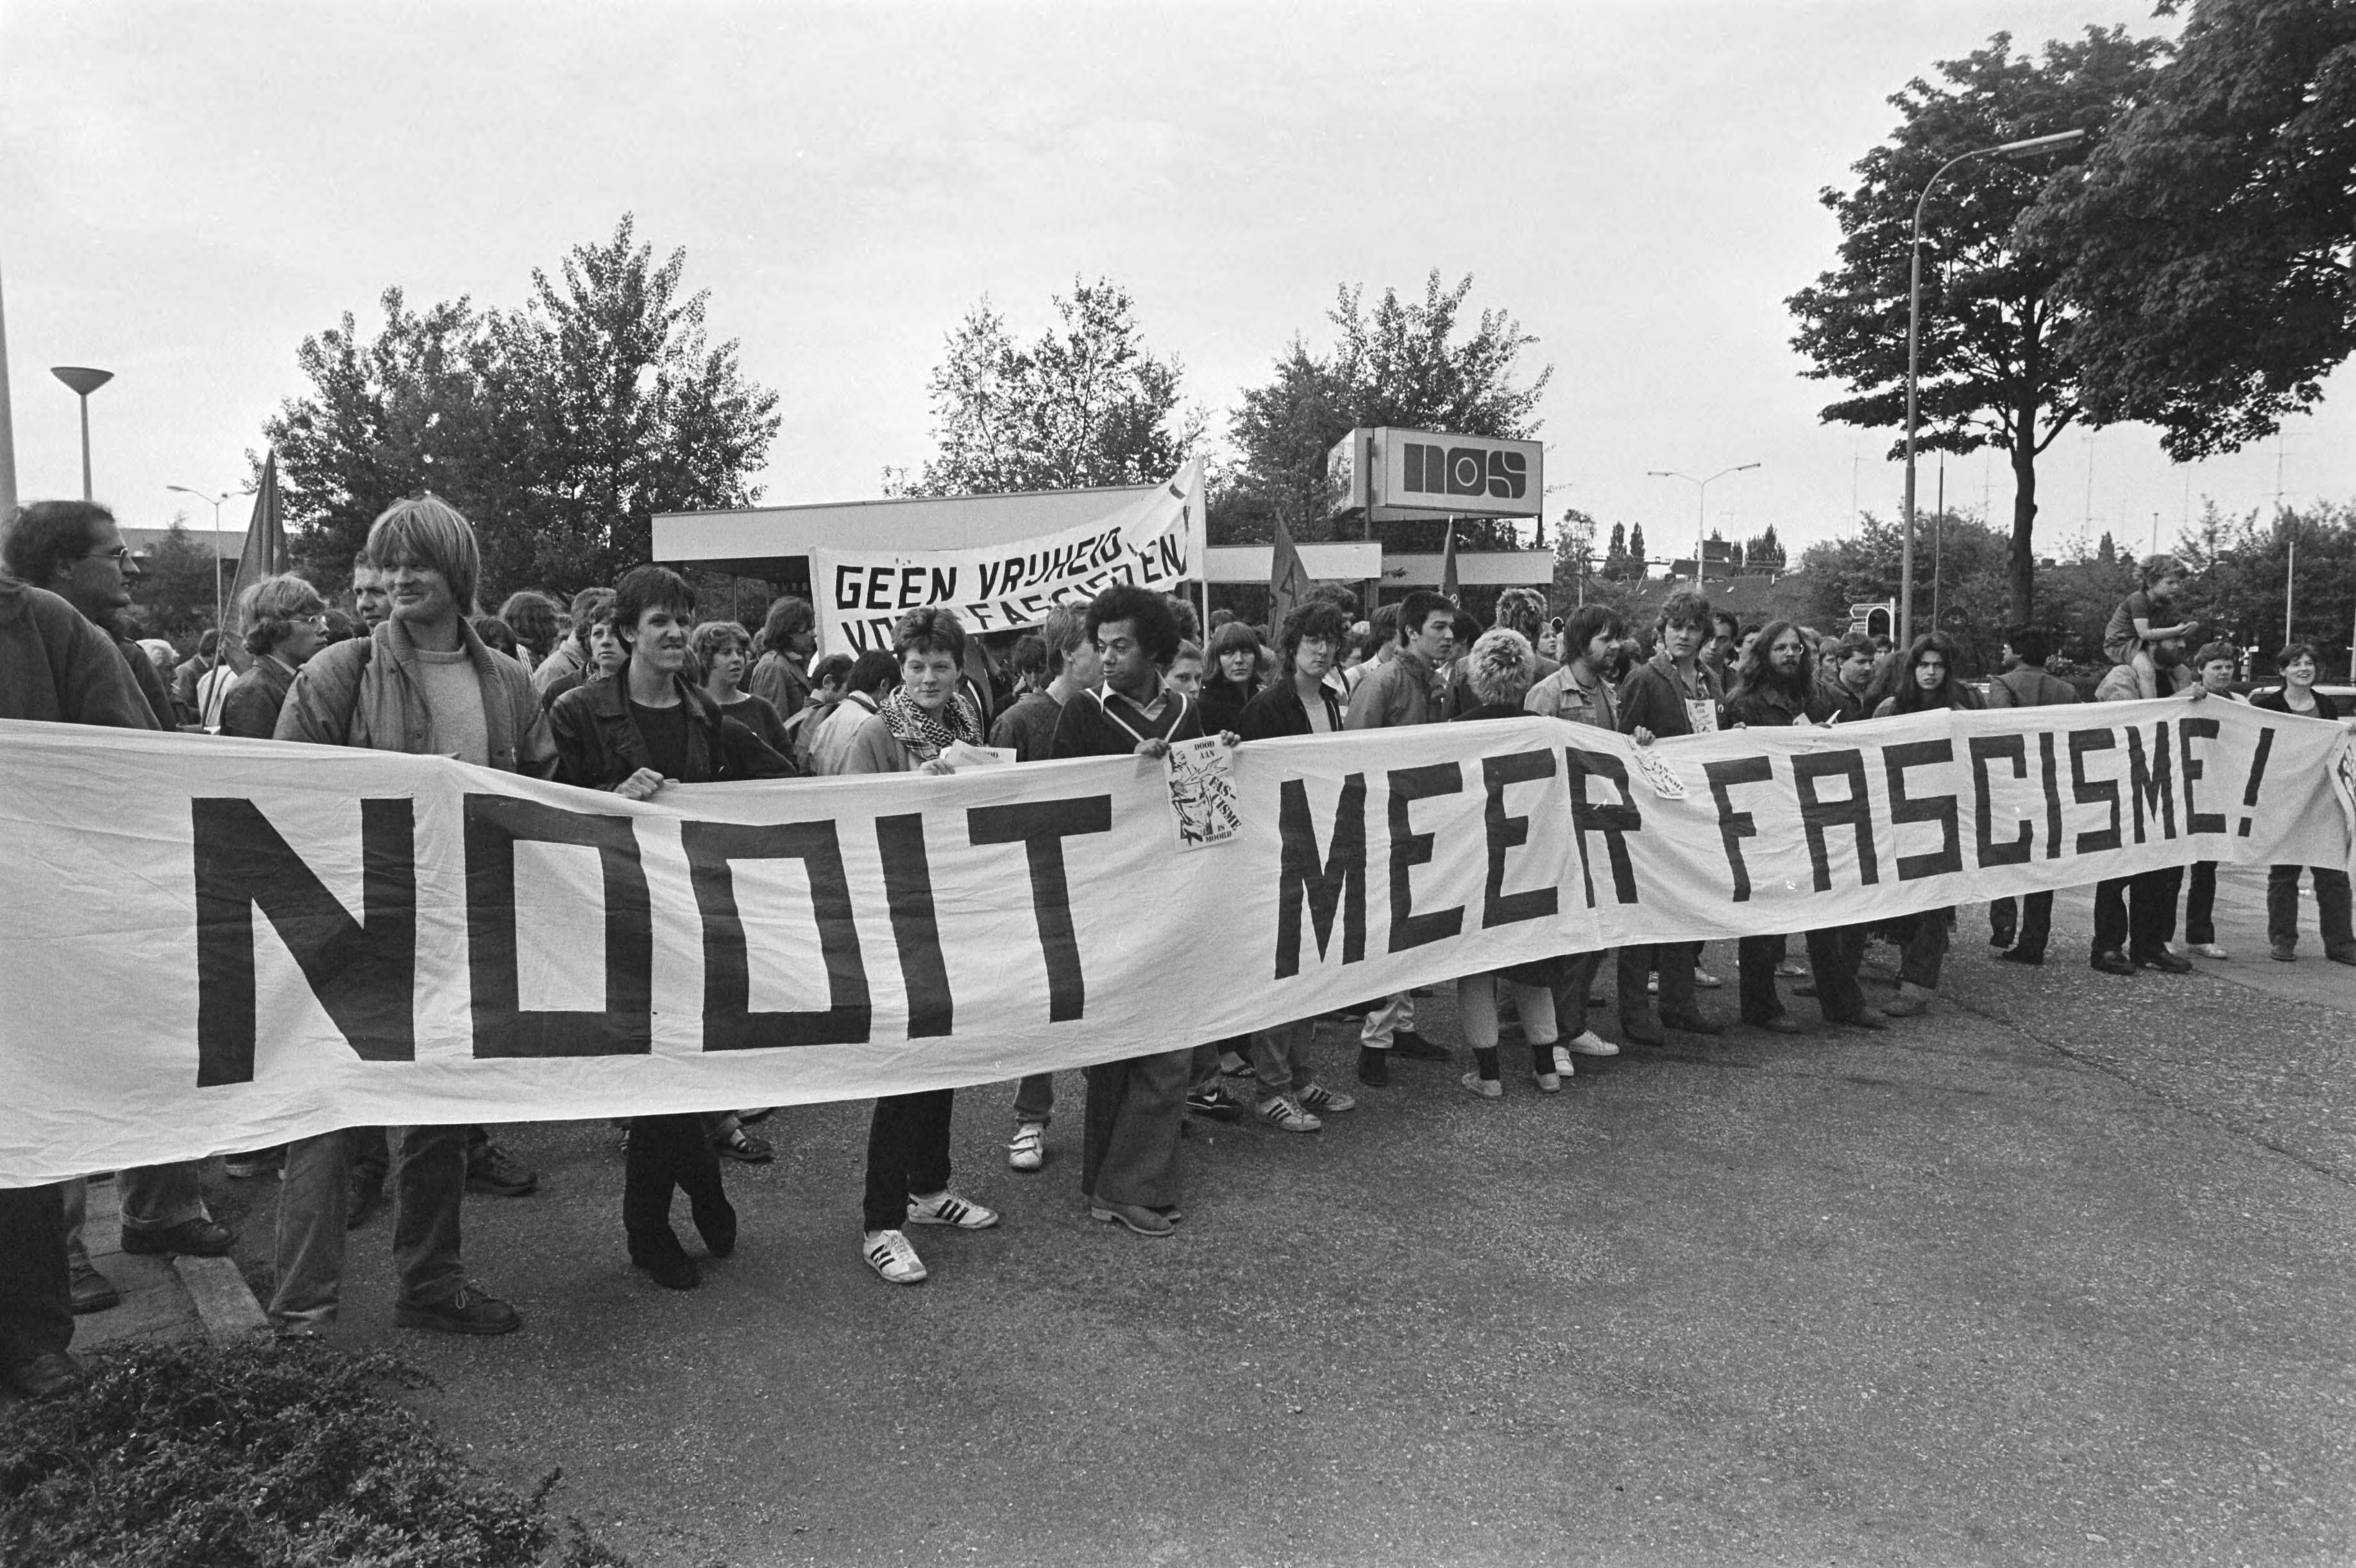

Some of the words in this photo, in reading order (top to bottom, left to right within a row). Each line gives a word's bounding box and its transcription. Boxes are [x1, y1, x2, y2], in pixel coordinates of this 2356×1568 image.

[1403, 443, 1527, 499] NOS
[835, 564, 957, 609] GEEN
[978, 526, 1122, 600] VRIJHEID
[1194, 740, 1215, 751] DOOD
[191, 792, 1112, 1088] NOOIT
[1274, 746, 1642, 980] MEER
[1702, 717, 2276, 903] FASCISME!
